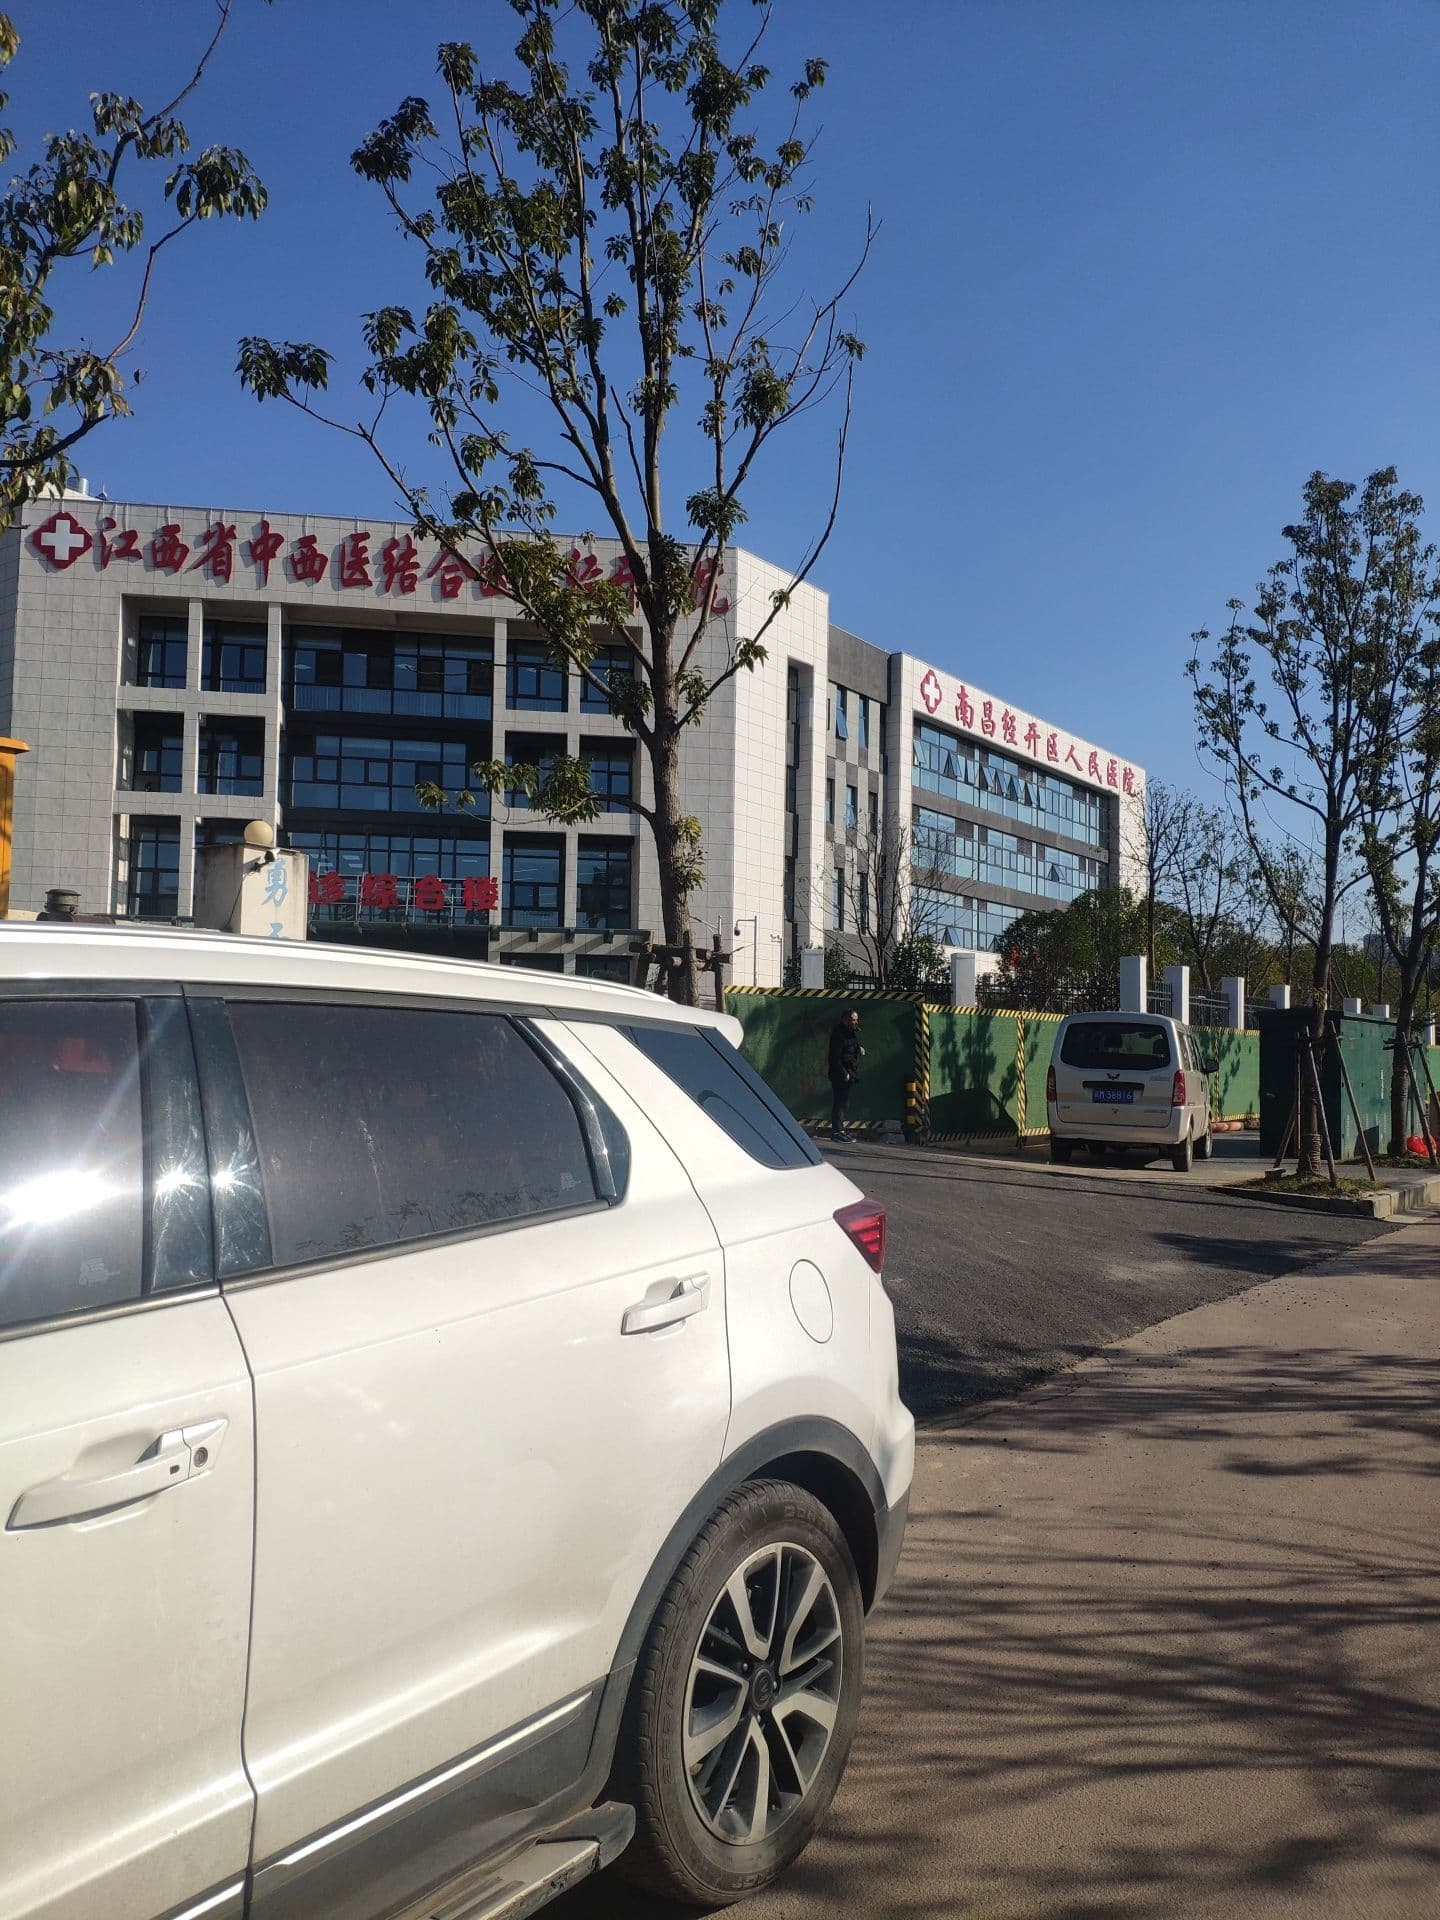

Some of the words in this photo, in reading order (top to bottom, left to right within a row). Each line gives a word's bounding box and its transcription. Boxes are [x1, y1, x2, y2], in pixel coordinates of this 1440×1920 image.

[954, 684, 1137, 797] 南昌经开区人民医院
